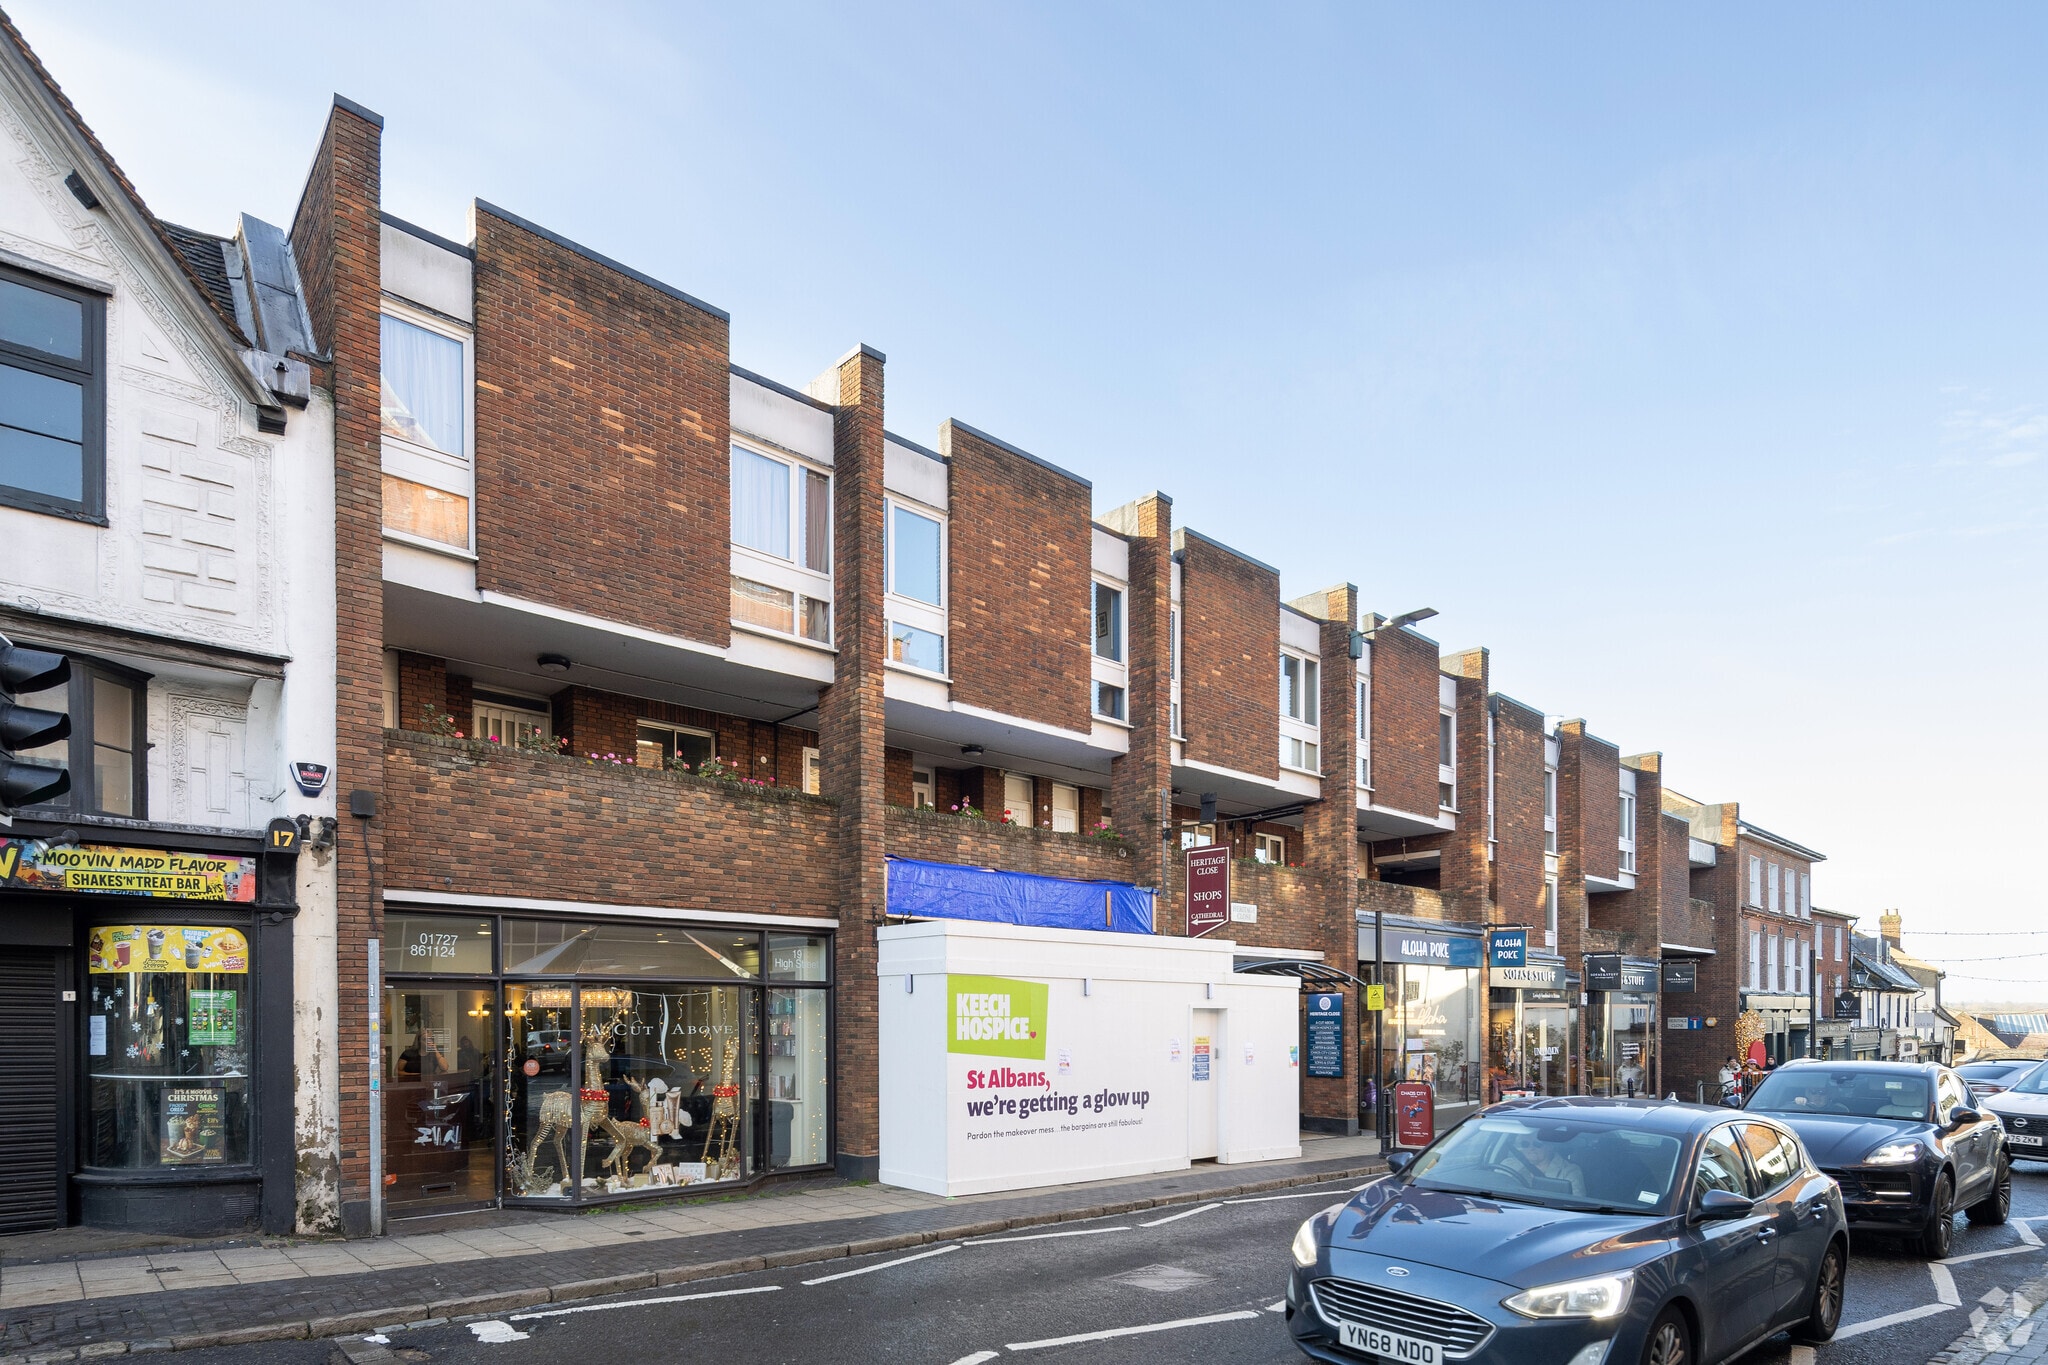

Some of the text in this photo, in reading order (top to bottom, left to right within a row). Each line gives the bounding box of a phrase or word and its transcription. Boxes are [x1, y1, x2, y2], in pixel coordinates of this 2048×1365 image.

[273, 830, 294, 847] 17
[43, 851, 227, 873] MOO'VIN MADD FLAVOR
[1190, 856, 1226, 867] HERITAGE
[1196, 866, 1219, 876] CLOSE
[176, 875, 201, 891] BAR
[1193, 890, 1222, 901] SHOPS
[1190, 911, 1224, 919] CATHEDRAL
[420, 933, 458, 945] 01727
[1495, 939, 1522, 948] ALOHA
[410, 944, 456, 957] 861124
[793, 950, 802, 959] 19
[1401, 940, 1449, 958] ALOHA POKE
[1497, 950, 1519, 960] POKE
[775, 958, 793, 971] High
[956, 993, 1011, 1017] KEECH
[588, 1023, 734, 1036] A CUT ABOVE
[956, 1016, 1030, 1041] HOSPICE
[966, 1067, 1051, 1092] St Albans,
[966, 1088, 1150, 1119] we're getting a glow up
[967, 1131, 992, 1141] Pardon
[993, 1129, 1004, 1138] the
[1005, 1127, 1037, 1137] makeover
[1071, 1122, 1097, 1132] bargains
[1107, 1120, 1118, 1128] still
[1118, 1118, 1143, 1127] fabulous!
[1347, 1325, 1433, 1364] YN68 NDO
